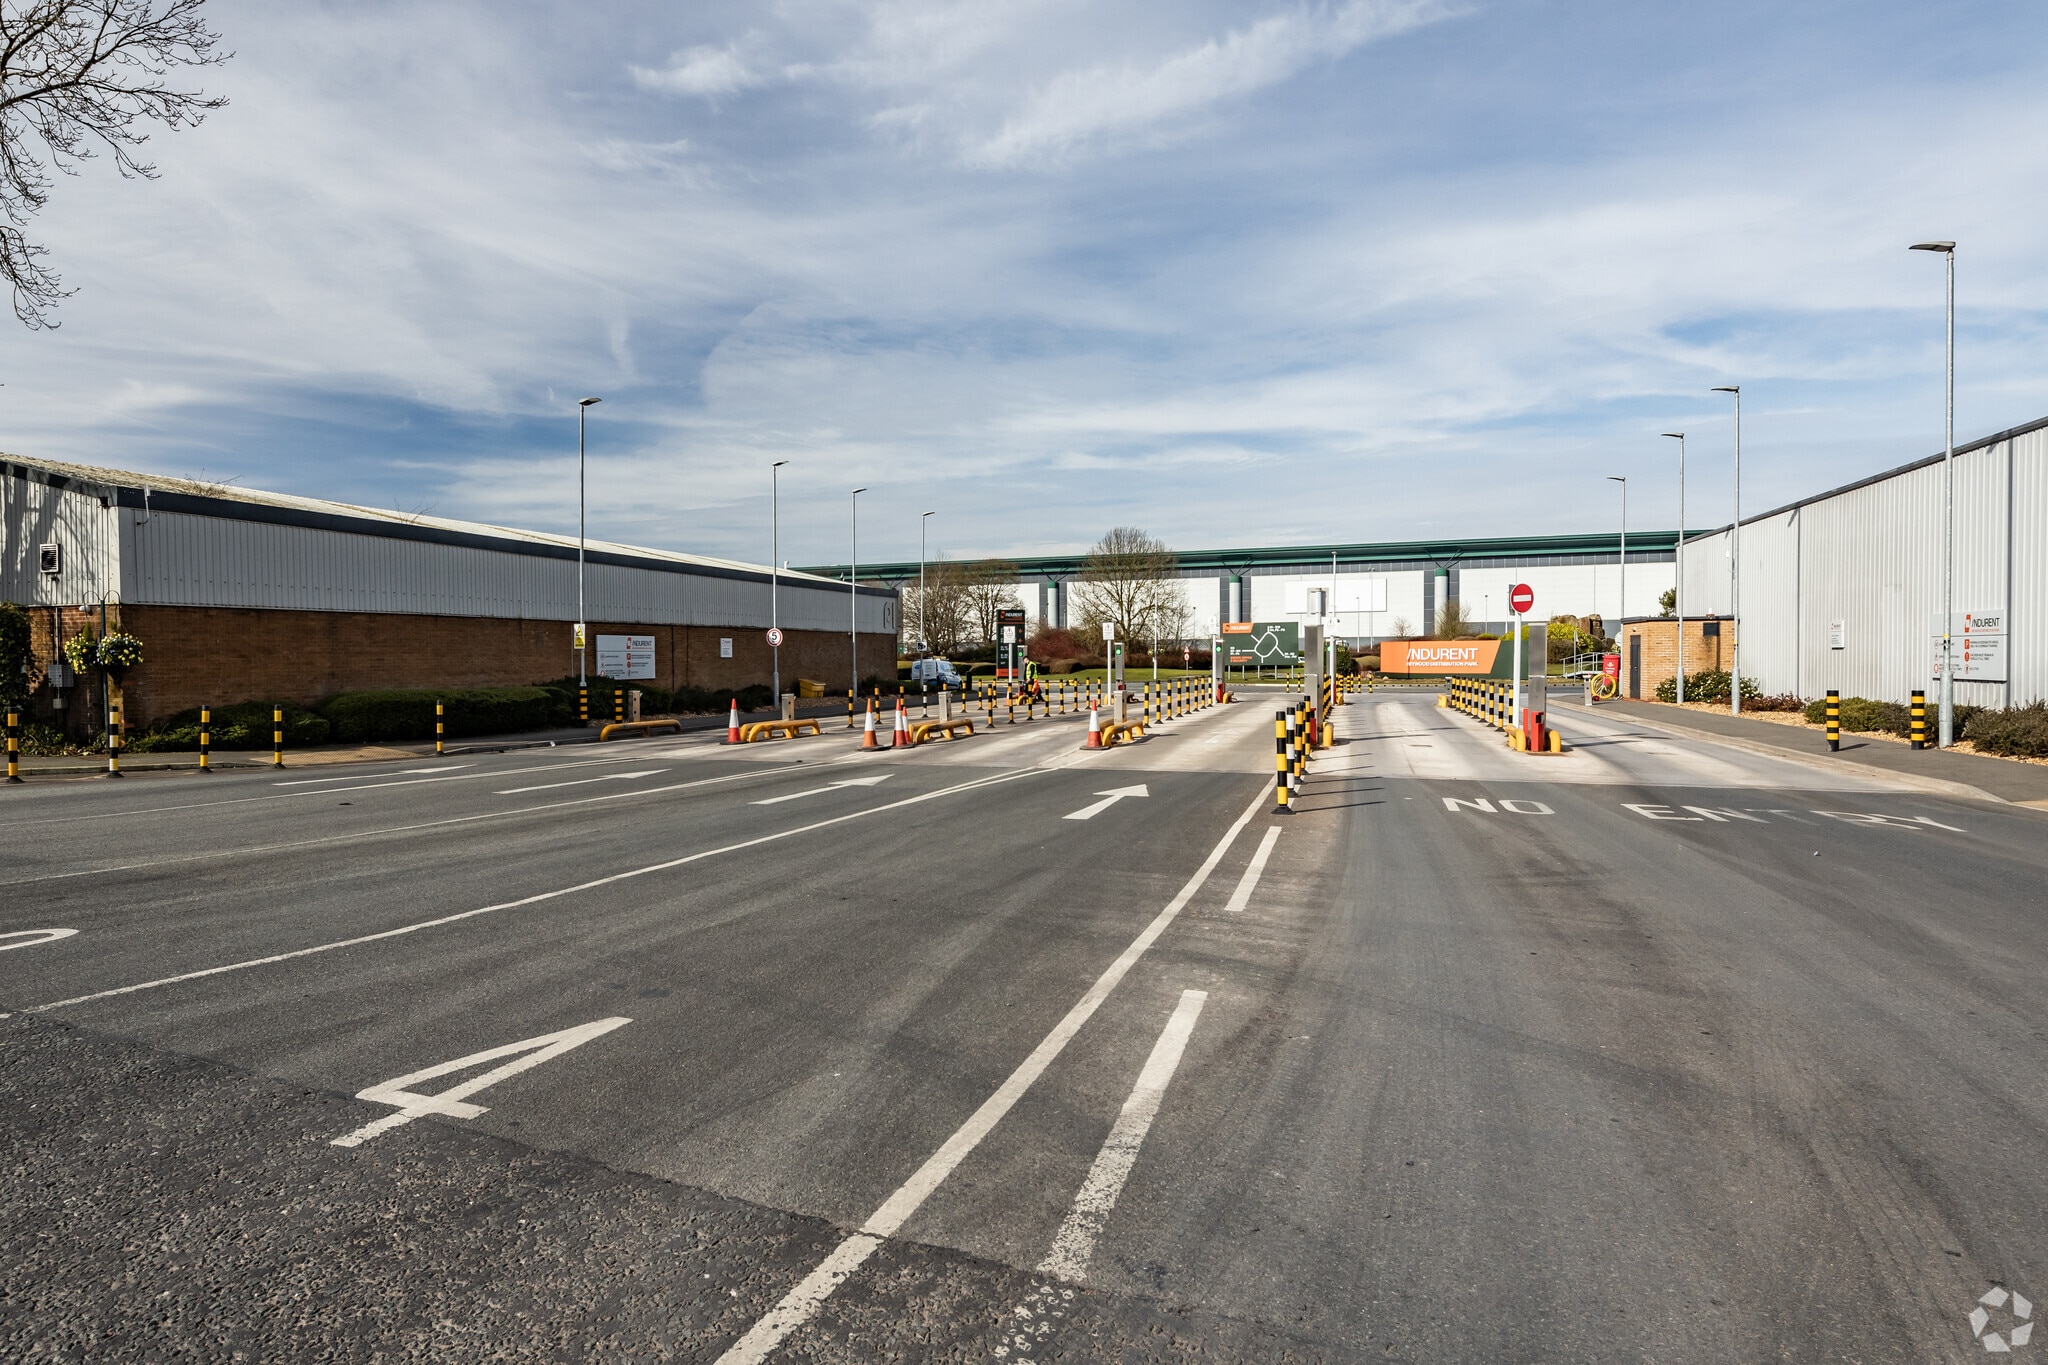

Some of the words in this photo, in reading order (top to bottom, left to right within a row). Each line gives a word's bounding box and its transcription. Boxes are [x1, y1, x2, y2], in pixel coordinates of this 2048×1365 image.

[772, 632, 777, 640] 5
[1441, 797, 1556, 815] NO
[329, 1015, 635, 1148] 4
